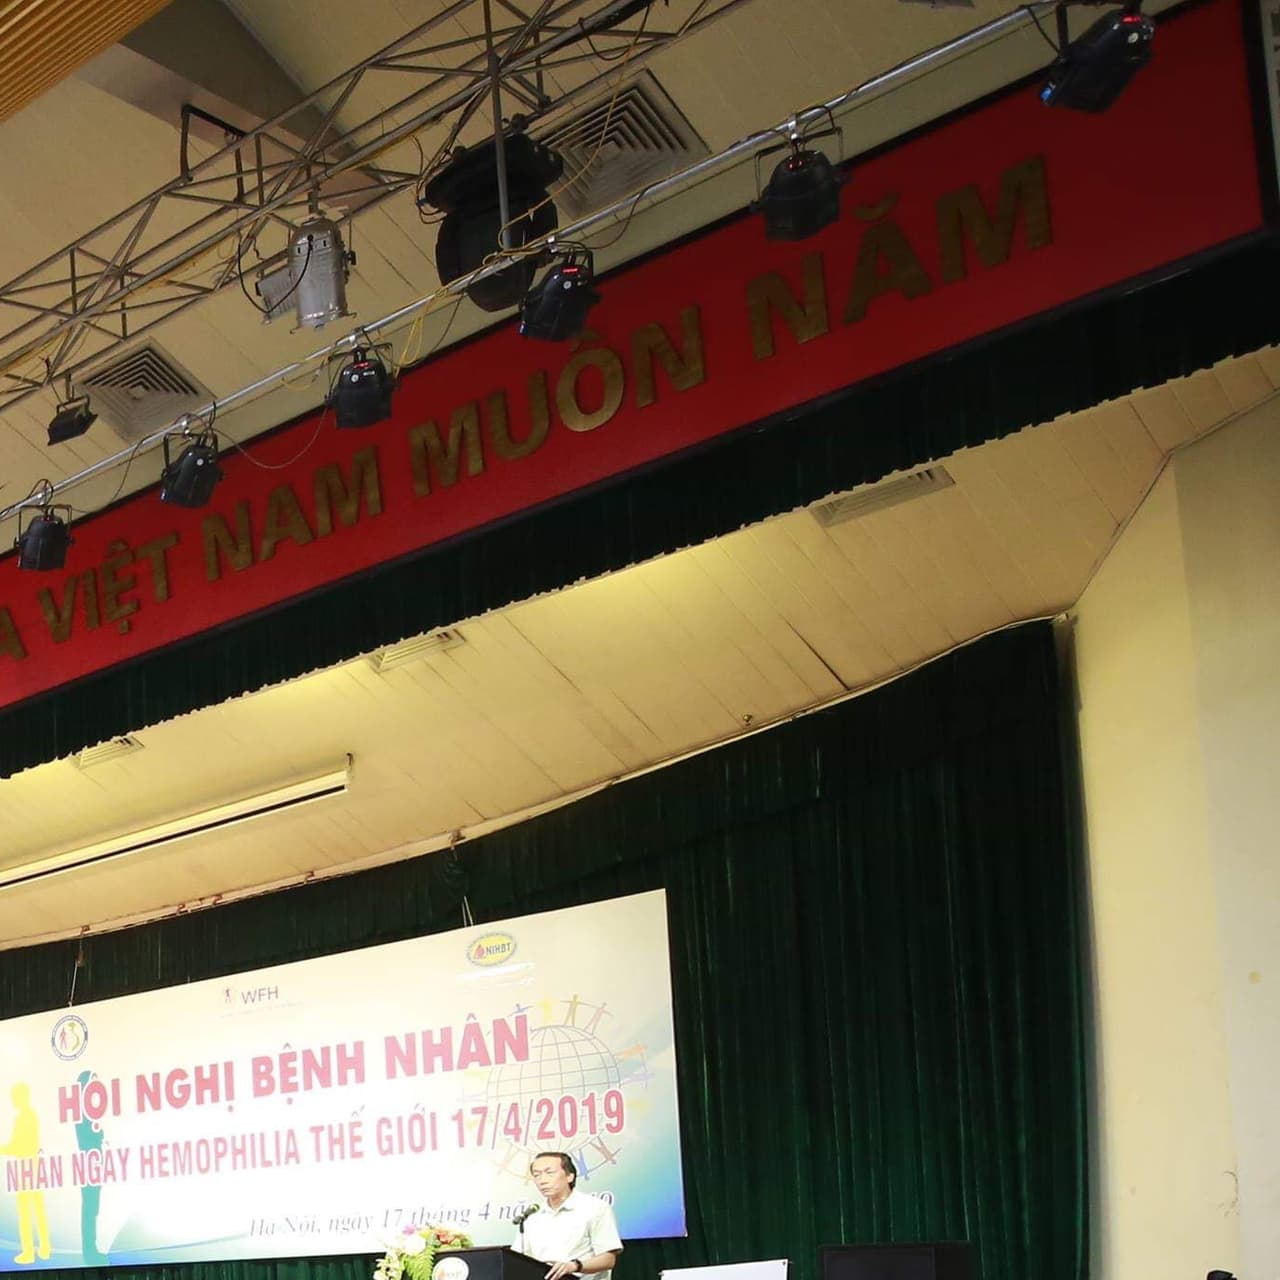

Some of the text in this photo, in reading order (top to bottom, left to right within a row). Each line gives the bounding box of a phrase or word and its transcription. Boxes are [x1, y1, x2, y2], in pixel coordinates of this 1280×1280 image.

[39, 533, 179, 643] VIỆT
[201, 445, 384, 583] NAM
[407, 305, 706, 497] MUÔN
[746, 151, 1054, 361] NĂM
[485, 942, 512, 956] NIHBT
[241, 985, 279, 1004] WFH
[58, 1012, 530, 1130] HỘI NGHỊ BỆNH NHÂN
[6, 1089, 625, 1193] NHÂN NGÀY HEMOPHILIA THẾ GIỚI 17/4/2019
[477, 1201, 490, 1221] 4
